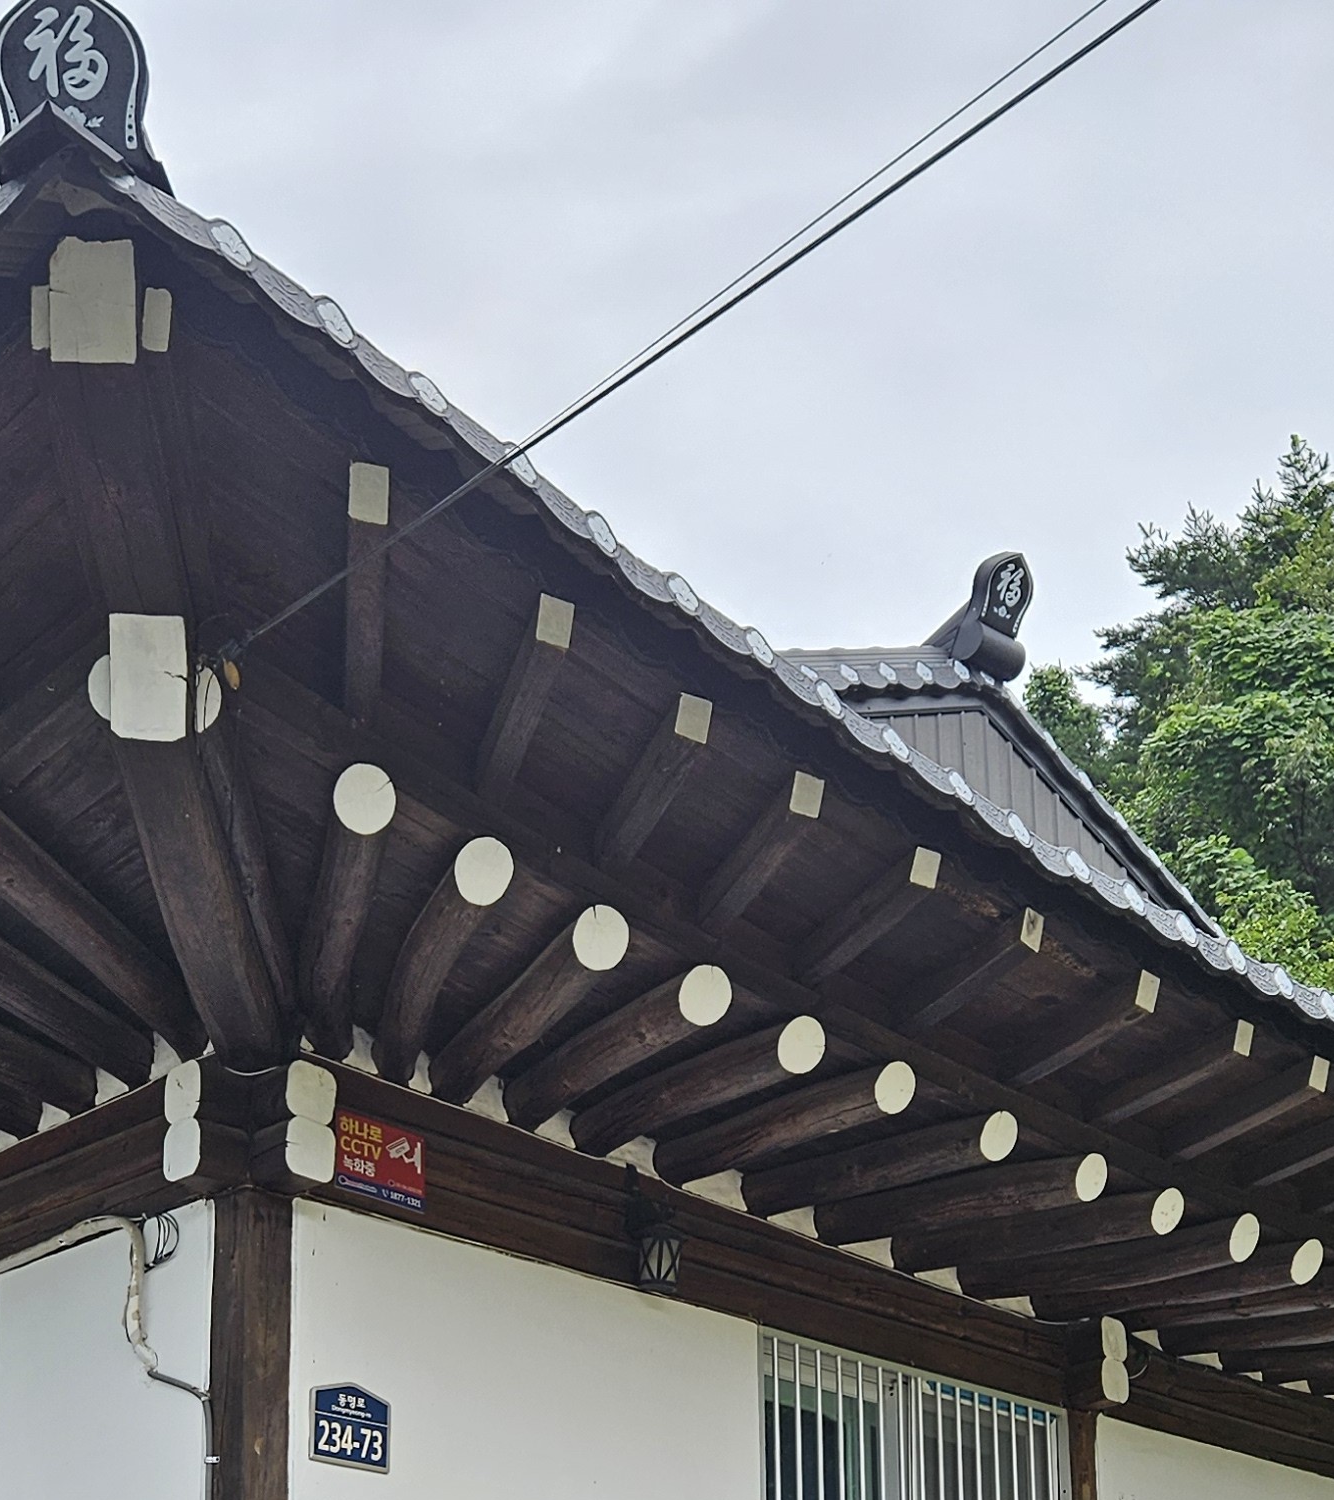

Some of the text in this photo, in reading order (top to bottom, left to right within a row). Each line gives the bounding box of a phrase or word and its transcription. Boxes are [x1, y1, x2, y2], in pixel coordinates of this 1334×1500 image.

[339, 1116, 383, 1143] 하나로
[340, 1135, 382, 1160] CCTV
[343, 1154, 376, 1177] 녹화중
[338, 1394, 366, 1409] 동명로
[318, 1420, 383, 1461] 234-73
